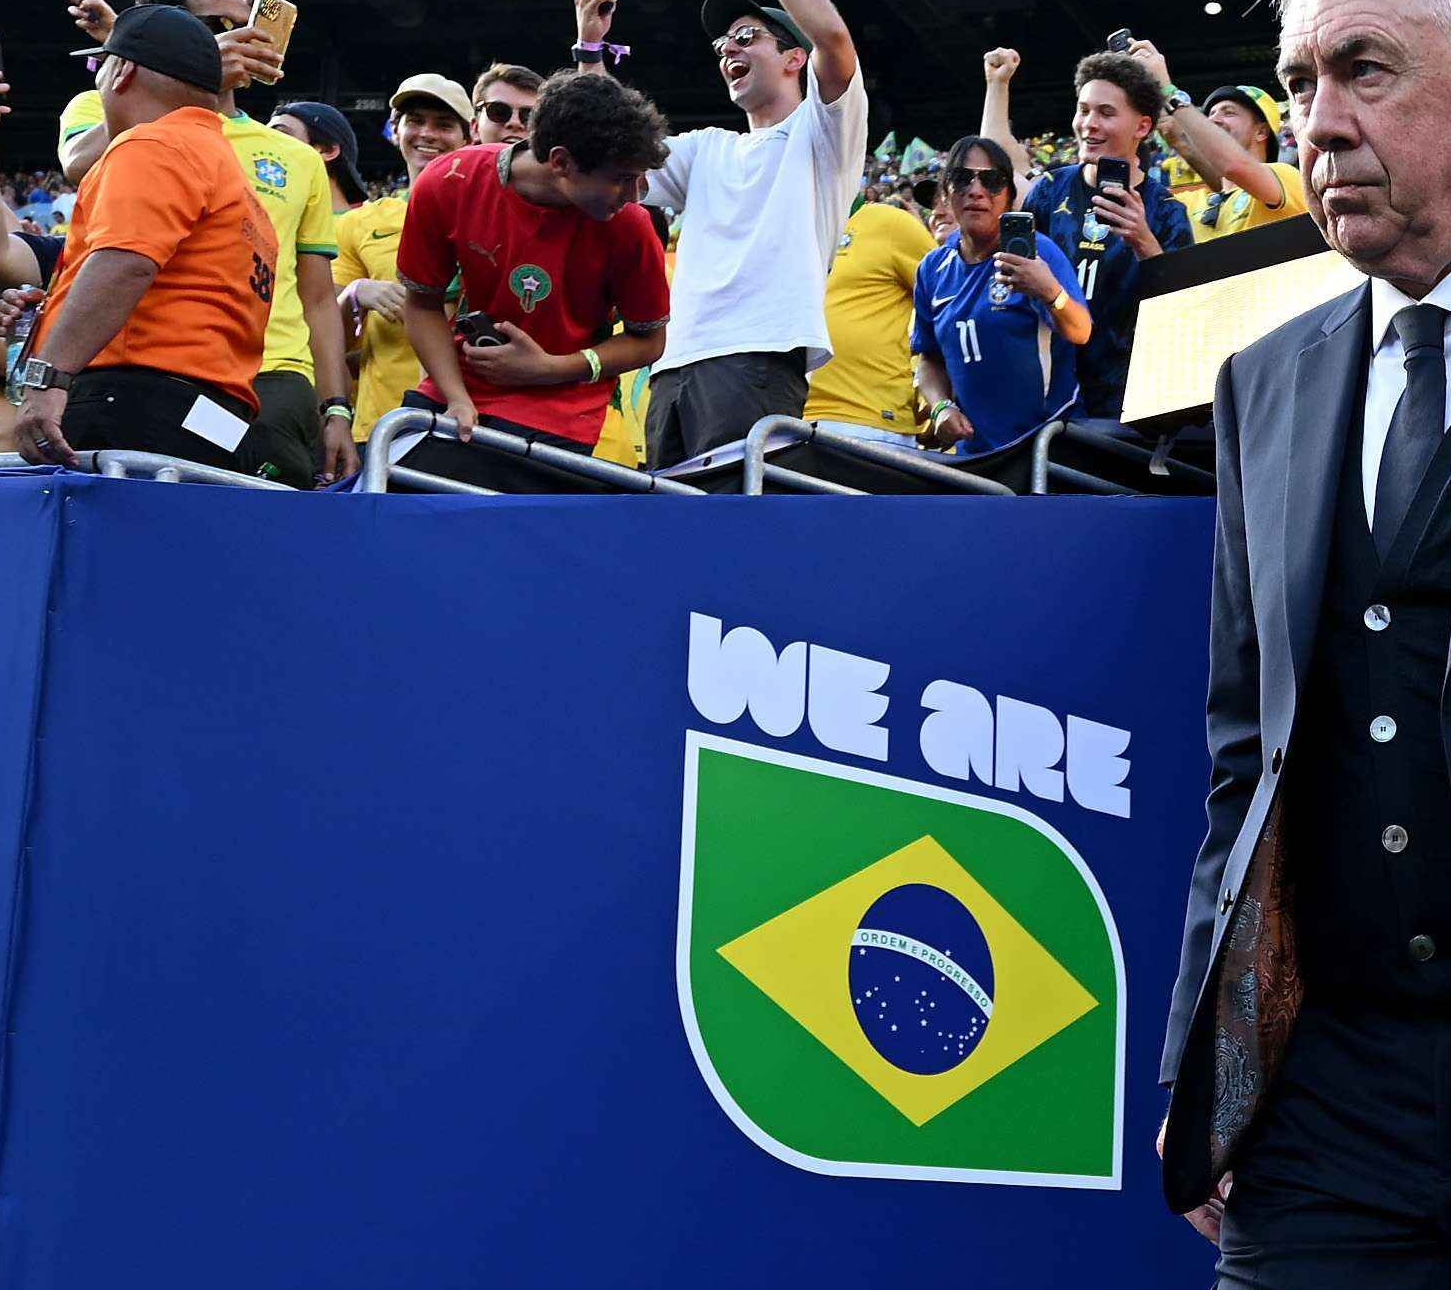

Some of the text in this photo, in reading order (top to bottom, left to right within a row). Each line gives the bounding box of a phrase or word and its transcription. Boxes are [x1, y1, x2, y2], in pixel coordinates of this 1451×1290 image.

[1076, 258, 1099, 300] 11
[955, 318, 983, 364] 11
[687, 610, 891, 762] WE
[860, 932, 989, 1008] ORDEM E PROGRESSO
